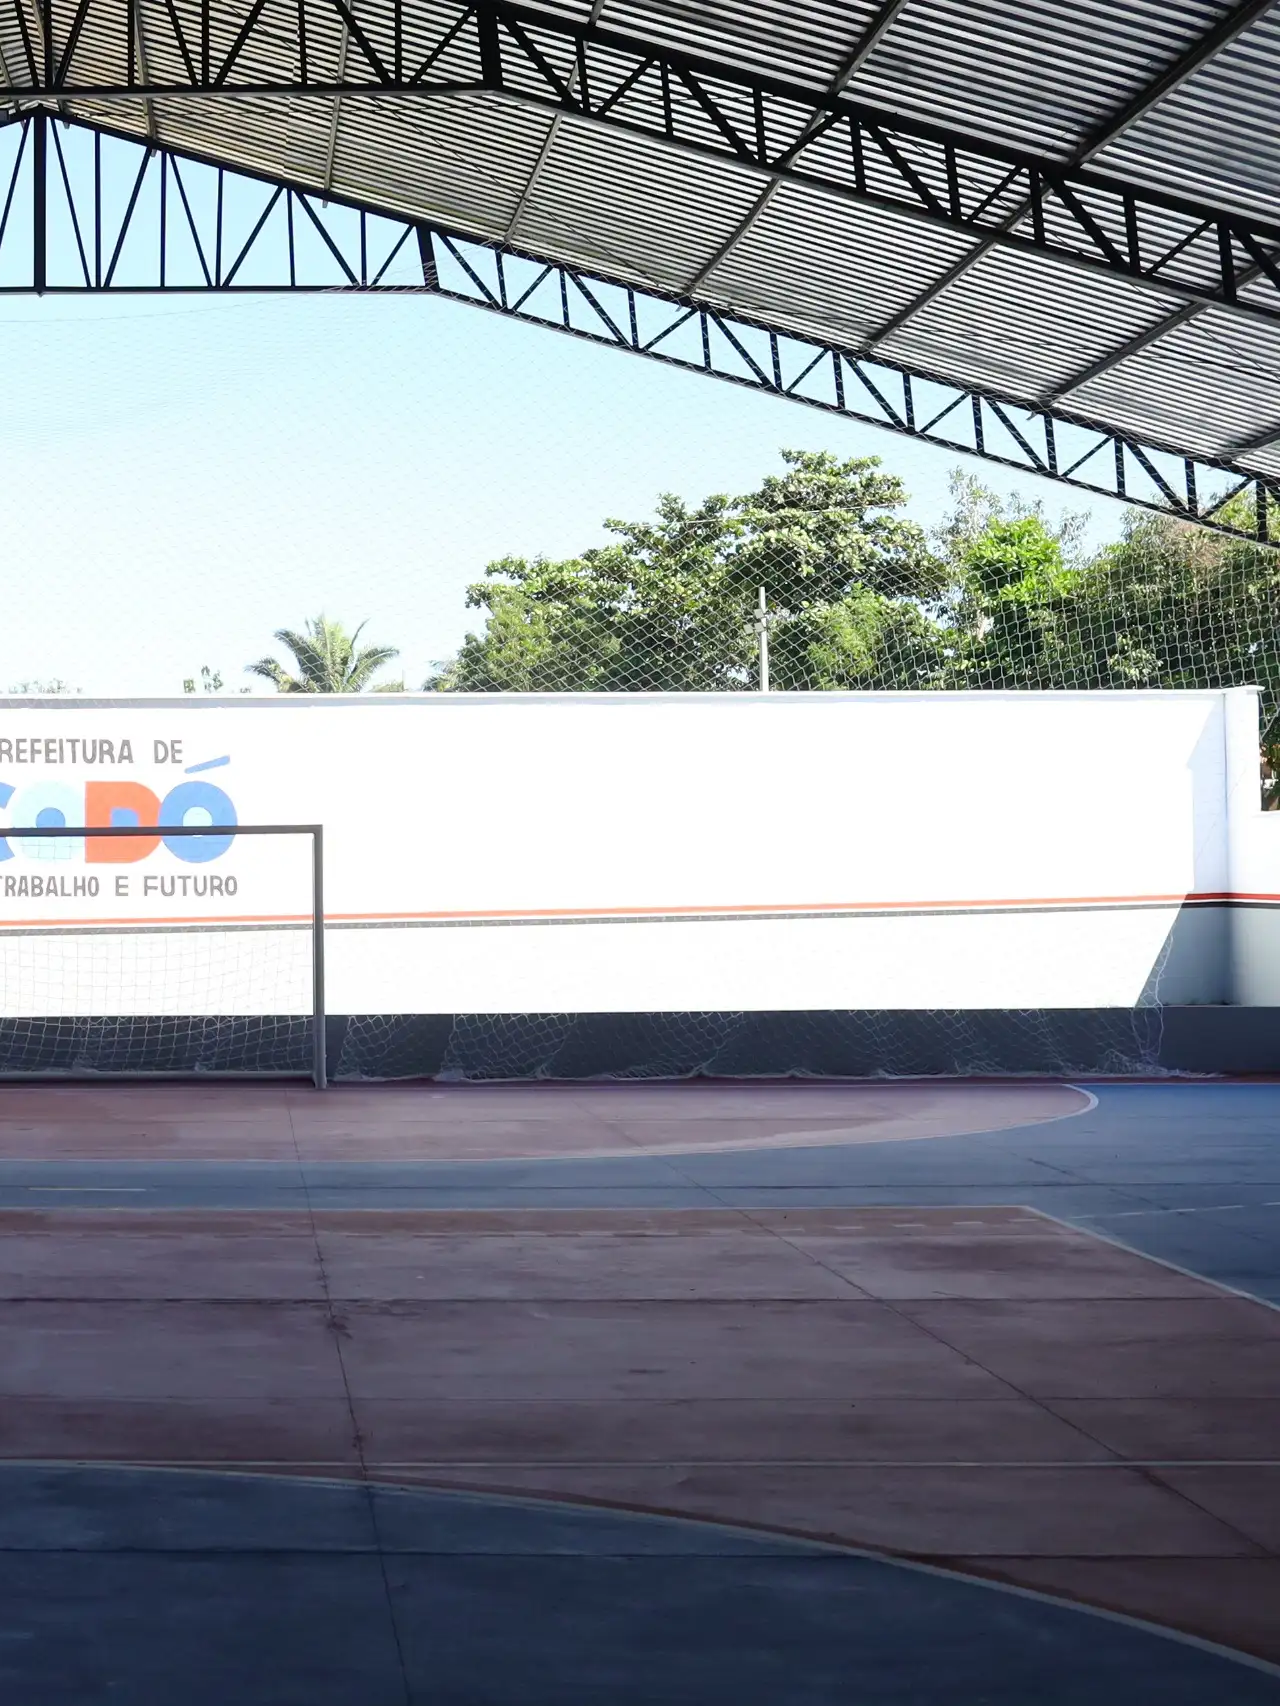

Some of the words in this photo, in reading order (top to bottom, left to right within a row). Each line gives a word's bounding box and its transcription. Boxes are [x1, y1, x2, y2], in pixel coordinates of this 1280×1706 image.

[153, 739, 183, 764] DE
[115, 875, 130, 897] E
[143, 875, 238, 897] FUTURO
